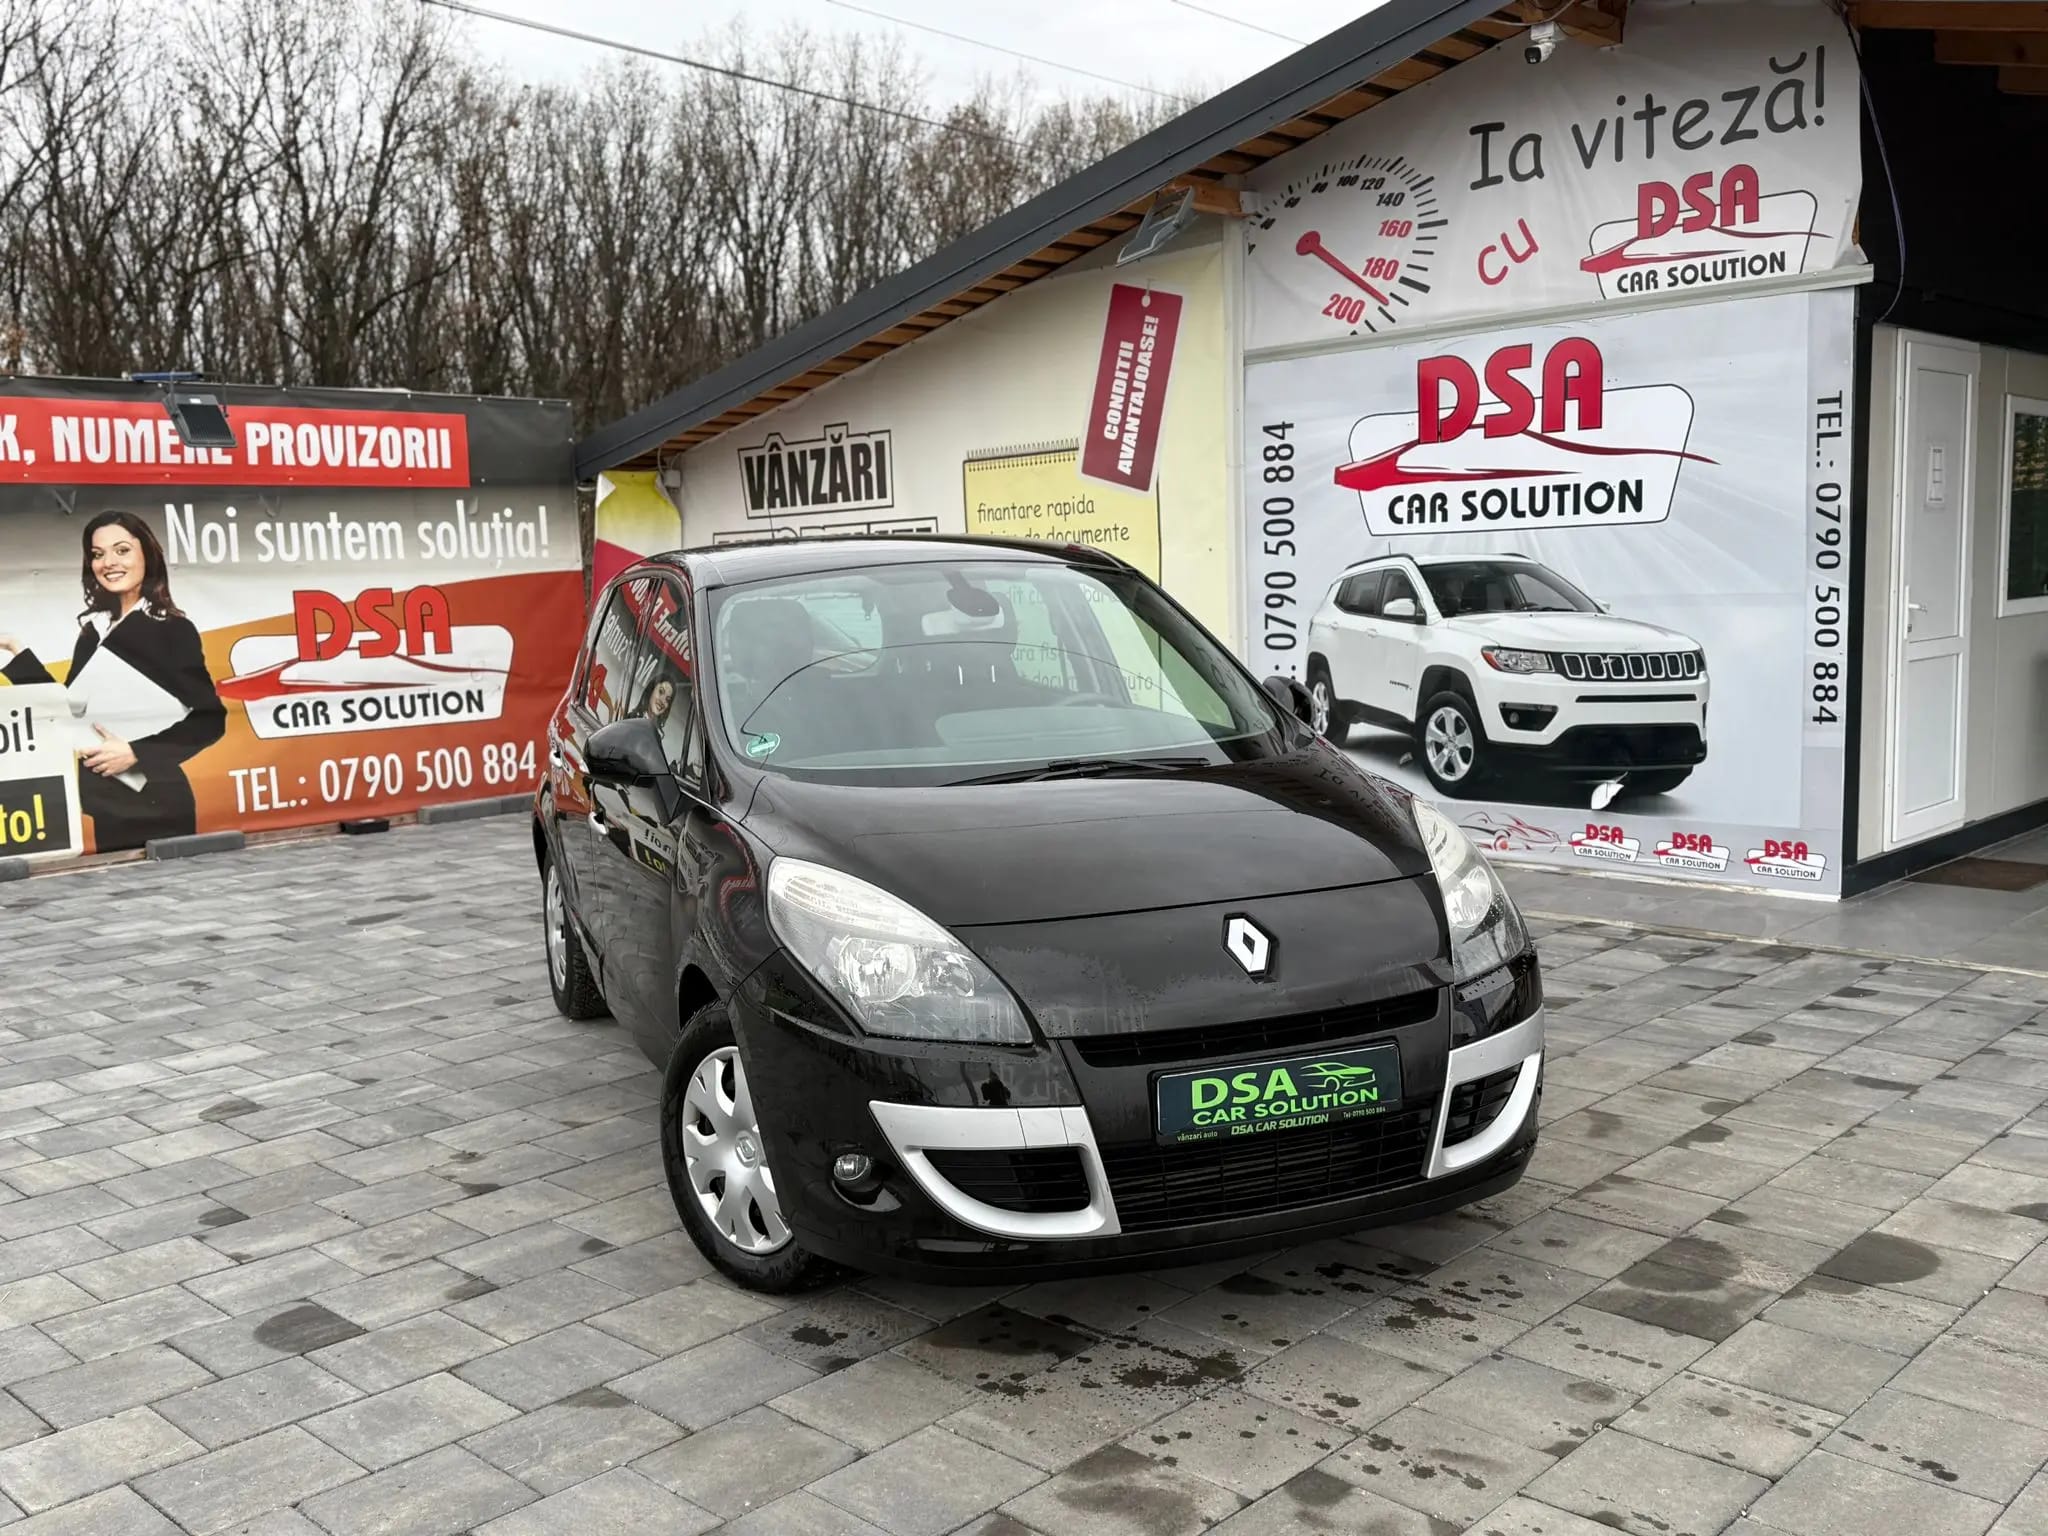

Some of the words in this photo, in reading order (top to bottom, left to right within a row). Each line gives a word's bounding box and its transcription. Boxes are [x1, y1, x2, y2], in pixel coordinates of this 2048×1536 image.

[1469, 122, 1545, 192] Ia
[1571, 45, 1826, 170] viteză!
[1336, 175, 1360, 187] 100
[1360, 177, 1385, 190] 120
[1376, 192, 1405, 207] 140
[1637, 164, 1760, 241] DSA
[1378, 220, 1412, 238] 160
[1362, 257, 1399, 281] 180
[1477, 218, 1539, 286] cu
[1617, 269, 1660, 294] CAR
[1668, 251, 1786, 288] SOLUTION
[1322, 294, 1365, 324] 200
[1104, 340, 1134, 441] CONDITII
[1117, 315, 1159, 475] AVANTAJOASE!
[1417, 337, 1603, 444] DSA
[51, 416, 233, 465] NUME
[247, 423, 451, 469] PROVIZORII
[1263, 420, 1296, 484] 884
[744, 433, 888, 509] VÂNZĂRI
[977, 502, 1042, 522] finantare
[1047, 494, 1095, 520] rapida
[1388, 494, 1448, 524] CAR
[1462, 479, 1644, 520] SOLUTION
[165, 504, 239, 563] Noi
[256, 512, 404, 562] suntem
[420, 500, 549, 569] soluția!
[1046, 523, 1130, 543] documente
[1264, 495, 1297, 558] 500
[1815, 481, 1842, 570] 0790
[293, 585, 453, 661] DSA
[1264, 570, 1297, 651] 0790
[1815, 584, 1841, 647] 500
[273, 700, 330, 729] CAR
[343, 690, 484, 724] SOLUTION
[1812, 660, 1838, 725] 884
[229, 769, 308, 813] TEL.:
[320, 753, 402, 802] 0790
[416, 747, 472, 791] 500
[484, 741, 536, 783] 884
[1578, 848, 1593, 857] CAR
[1594, 849, 1632, 860] SOLUTION
[1585, 824, 1624, 844] DSA
[1672, 832, 1713, 853] DSA
[1764, 840, 1808, 861] DSA
[1664, 857, 1680, 866] CAR
[1681, 858, 1722, 870] SOLUTION
[1756, 866, 1773, 875] CAR
[1775, 867, 1817, 879] SOLUTION
[1191, 1068, 1298, 1110] DSA
[1193, 1107, 1246, 1125] CAR
[1254, 1087, 1378, 1117] SOLUTION
[1231, 1125, 1254, 1135] DSA
[1256, 1121, 1276, 1132] CAR
[1279, 1113, 1329, 1129] SOLUTION
